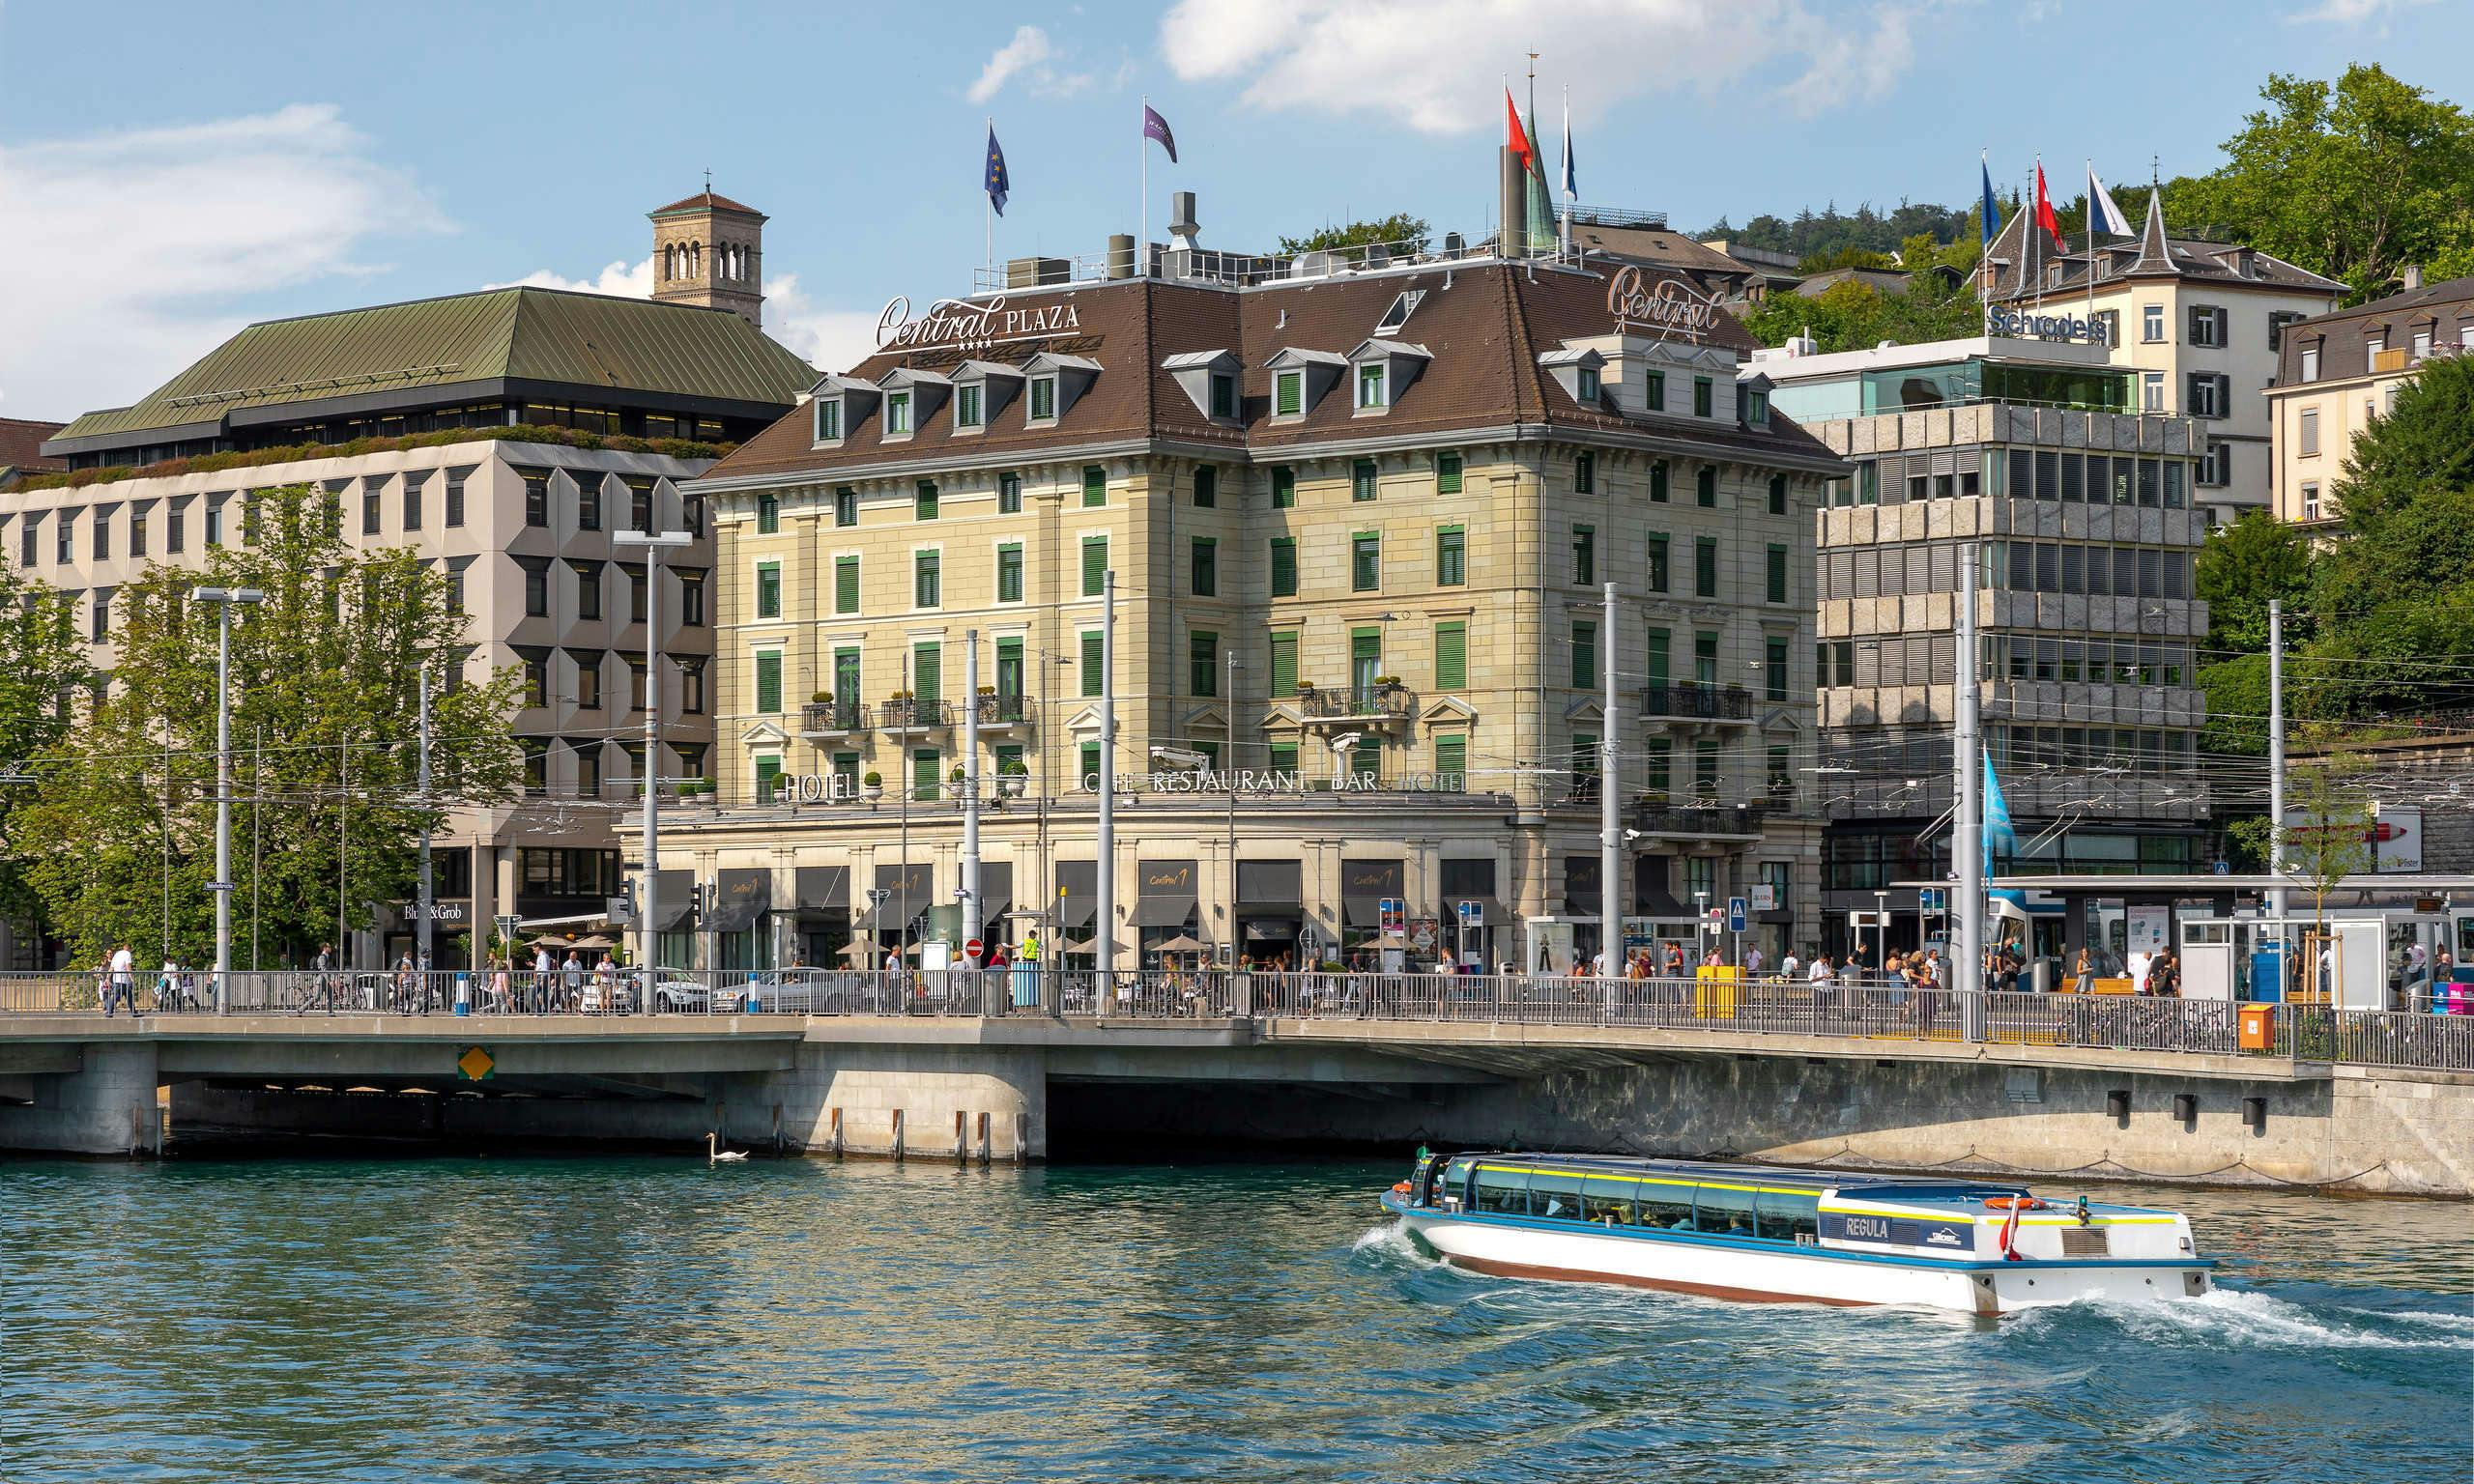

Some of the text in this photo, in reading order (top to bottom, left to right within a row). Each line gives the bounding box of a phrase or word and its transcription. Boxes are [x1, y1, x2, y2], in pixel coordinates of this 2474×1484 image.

[1608, 265, 1726, 329] Central
[874, 295, 1080, 349] Central PLAZA
[1987, 304, 2110, 341] Schroders
[785, 773, 857, 801] HOTEL
[1084, 770, 1378, 792] CFE RESTAURANT BAR
[1398, 772, 1465, 792] HOTEL
[1846, 1217, 1888, 1239] REGULA
